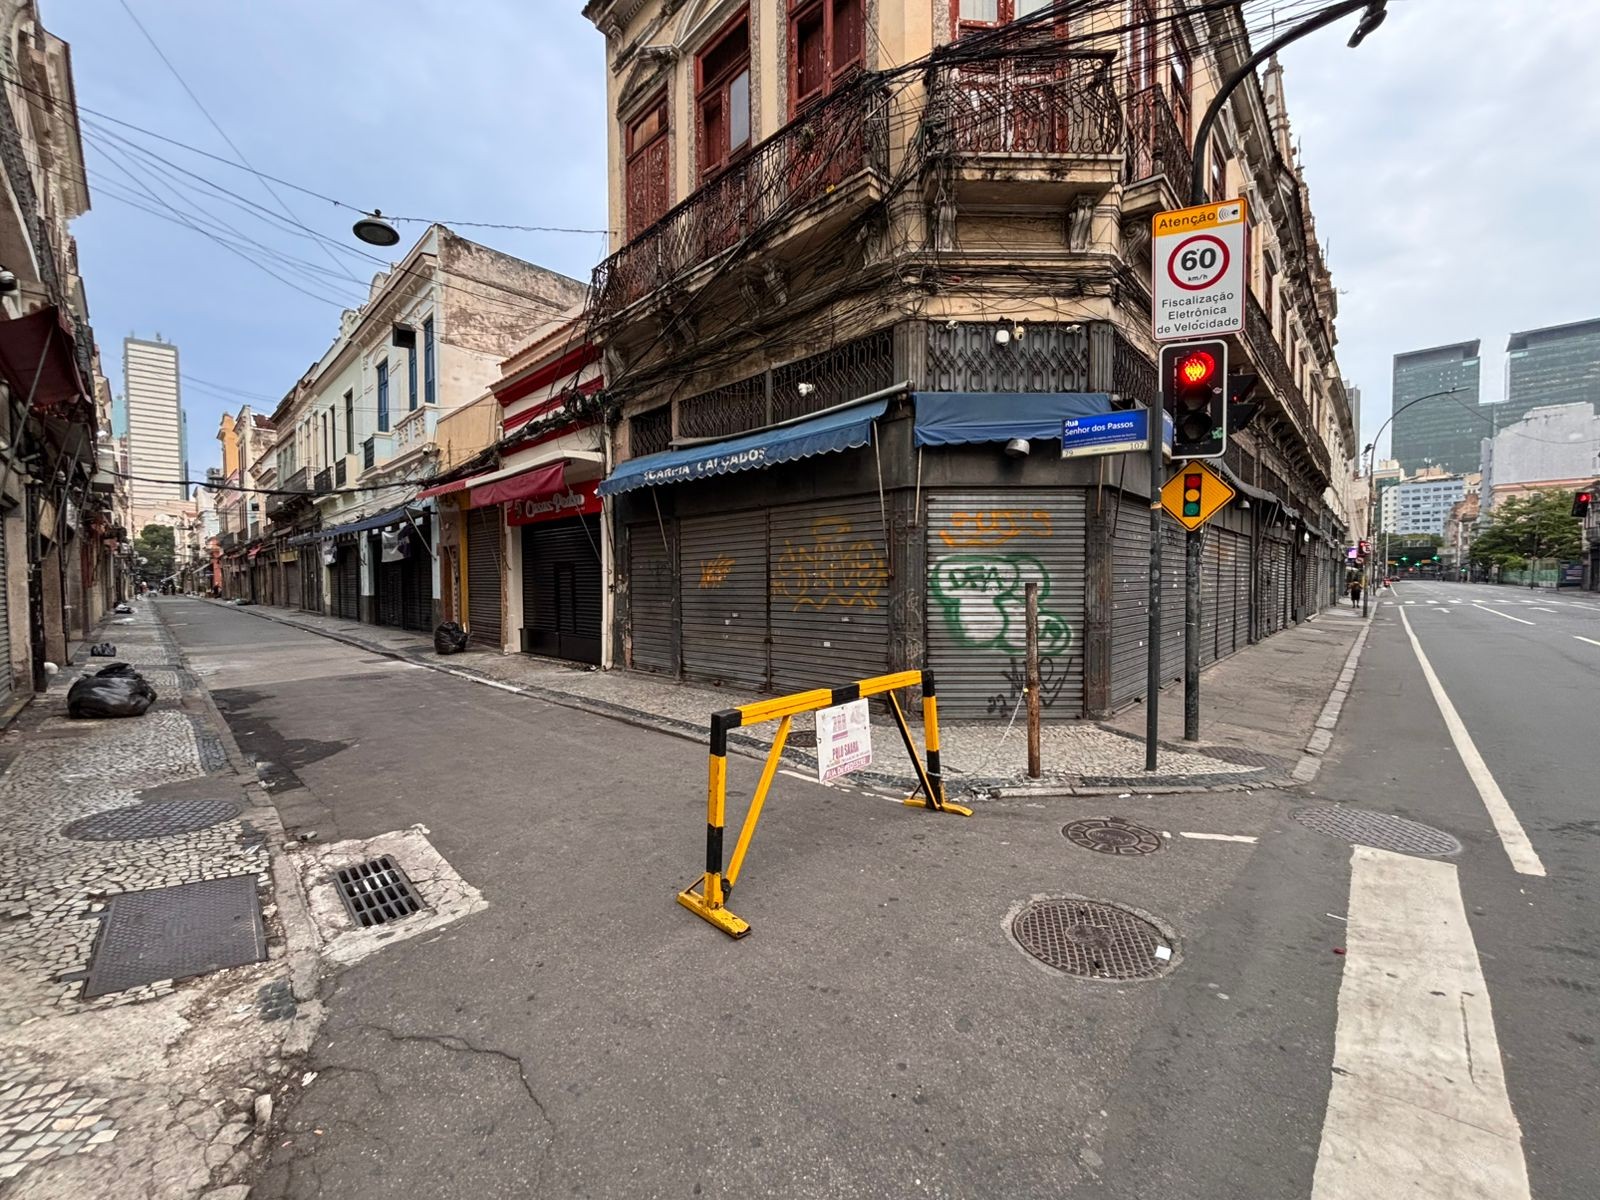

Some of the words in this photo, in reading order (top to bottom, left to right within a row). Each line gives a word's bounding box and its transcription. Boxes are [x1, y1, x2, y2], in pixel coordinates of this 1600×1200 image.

[1159, 211, 1216, 229] Atenção
[1181, 247, 1216, 271] 60
[1162, 291, 1234, 308] Fiscalização
[1168, 305, 1227, 320] Eletrônica
[1157, 325, 1171, 334] de
[1174, 316, 1239, 332] Velocidade
[1065, 427, 1090, 436] Senhor
[1091, 424, 1106, 432] dos
[1107, 421, 1134, 430] Passos
